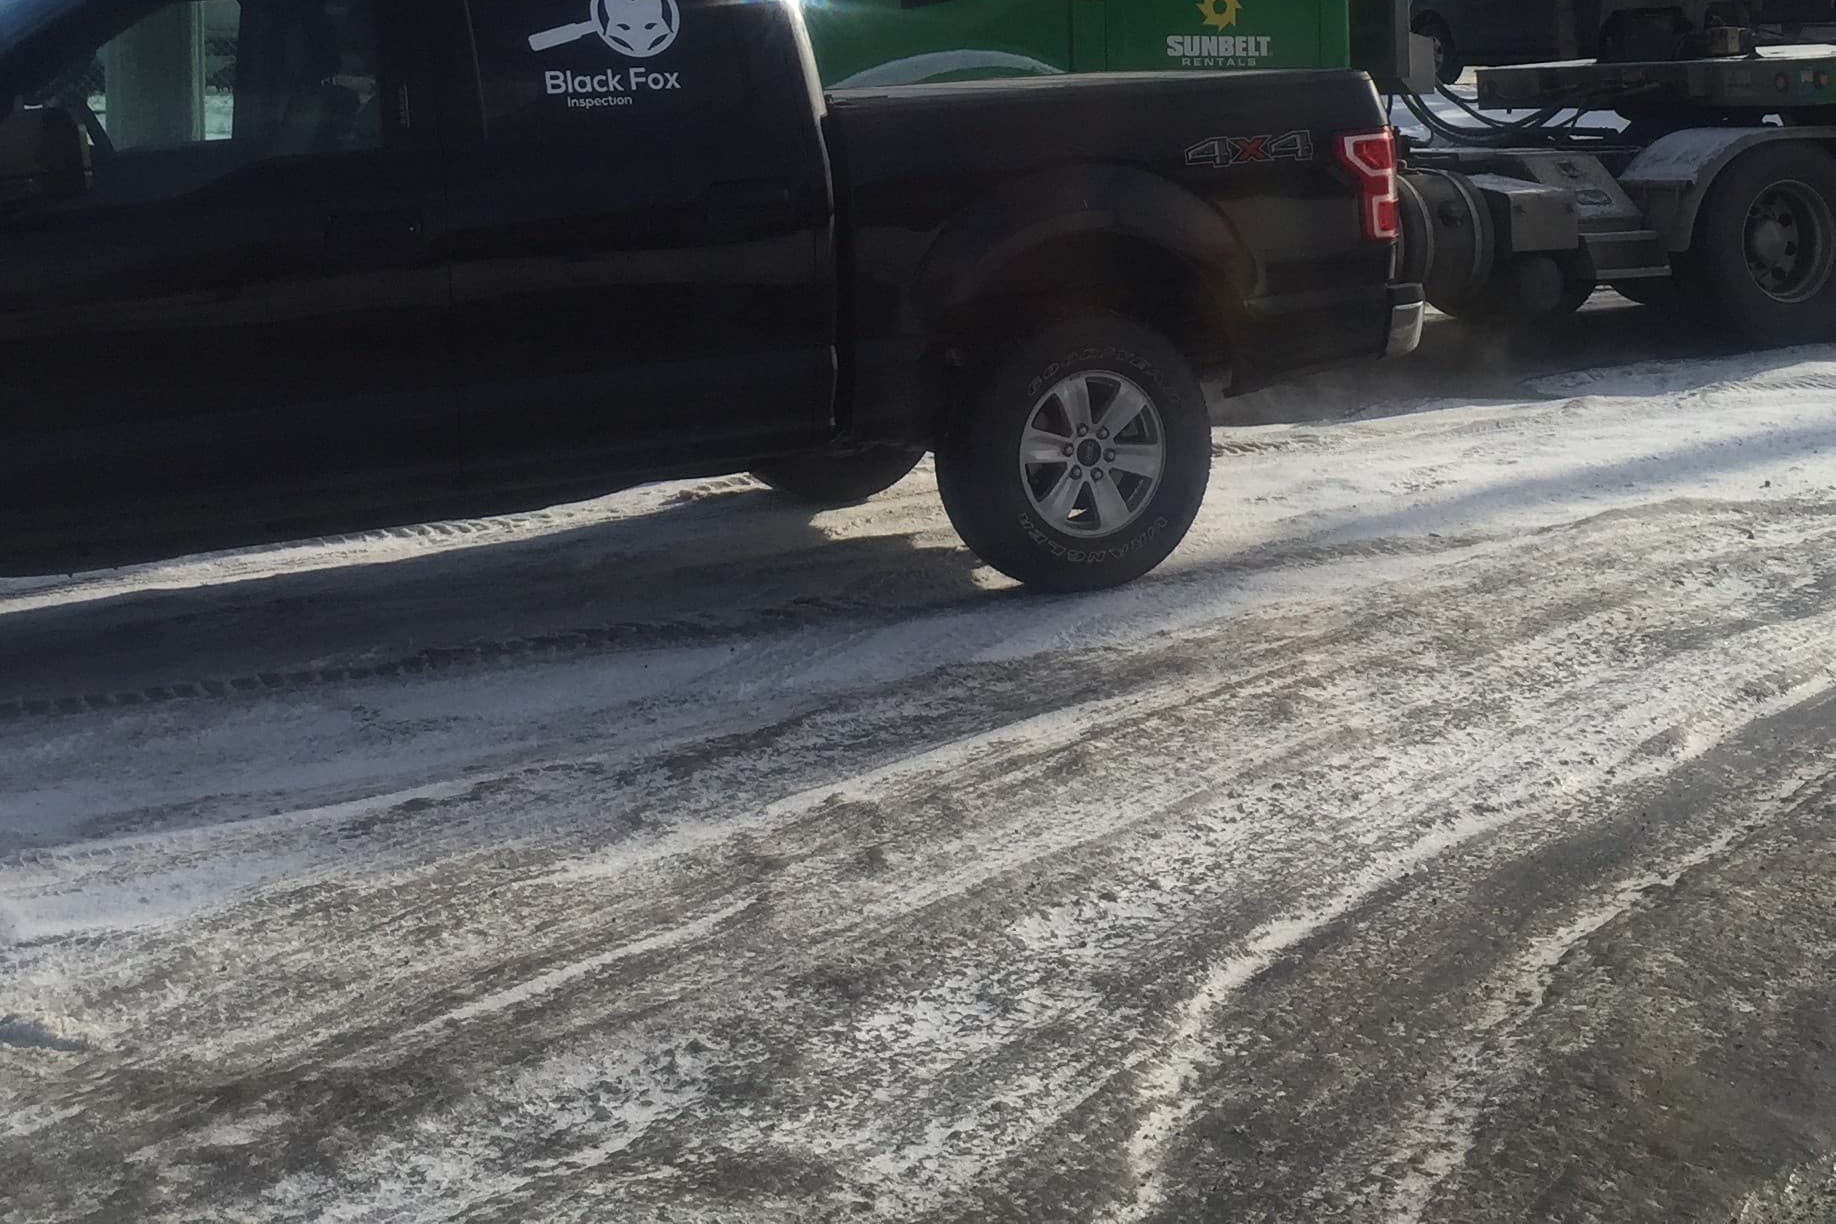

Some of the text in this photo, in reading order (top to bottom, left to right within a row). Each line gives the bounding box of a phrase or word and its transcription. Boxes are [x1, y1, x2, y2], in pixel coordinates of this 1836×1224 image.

[1166, 35, 1271, 57] SUNBELT
[1181, 57, 1257, 67] RENTALS
[544, 67, 682, 95] Black Fox
[567, 95, 633, 109] Inspection
